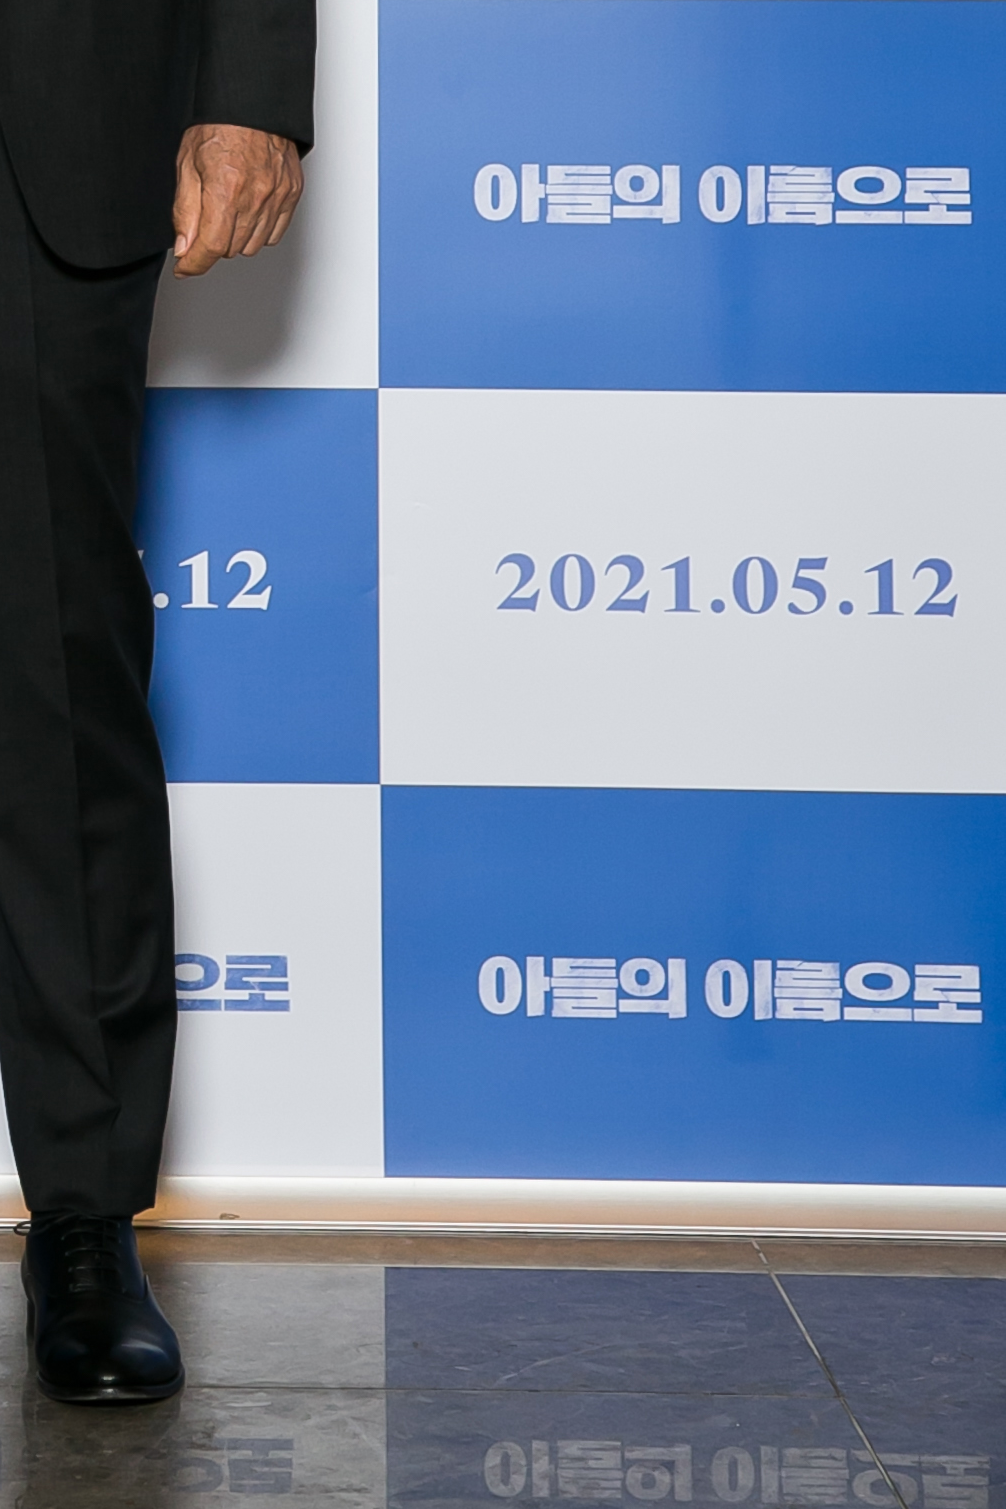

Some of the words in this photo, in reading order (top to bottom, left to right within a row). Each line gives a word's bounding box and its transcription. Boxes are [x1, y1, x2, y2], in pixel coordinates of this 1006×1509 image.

[474, 163, 681, 225] 아들의
[698, 164, 973, 226] 이름으로
[495, 553, 958, 618] 2021.05.12
[478, 955, 688, 1019] 아들의
[705, 958, 984, 1024] 이름으로
